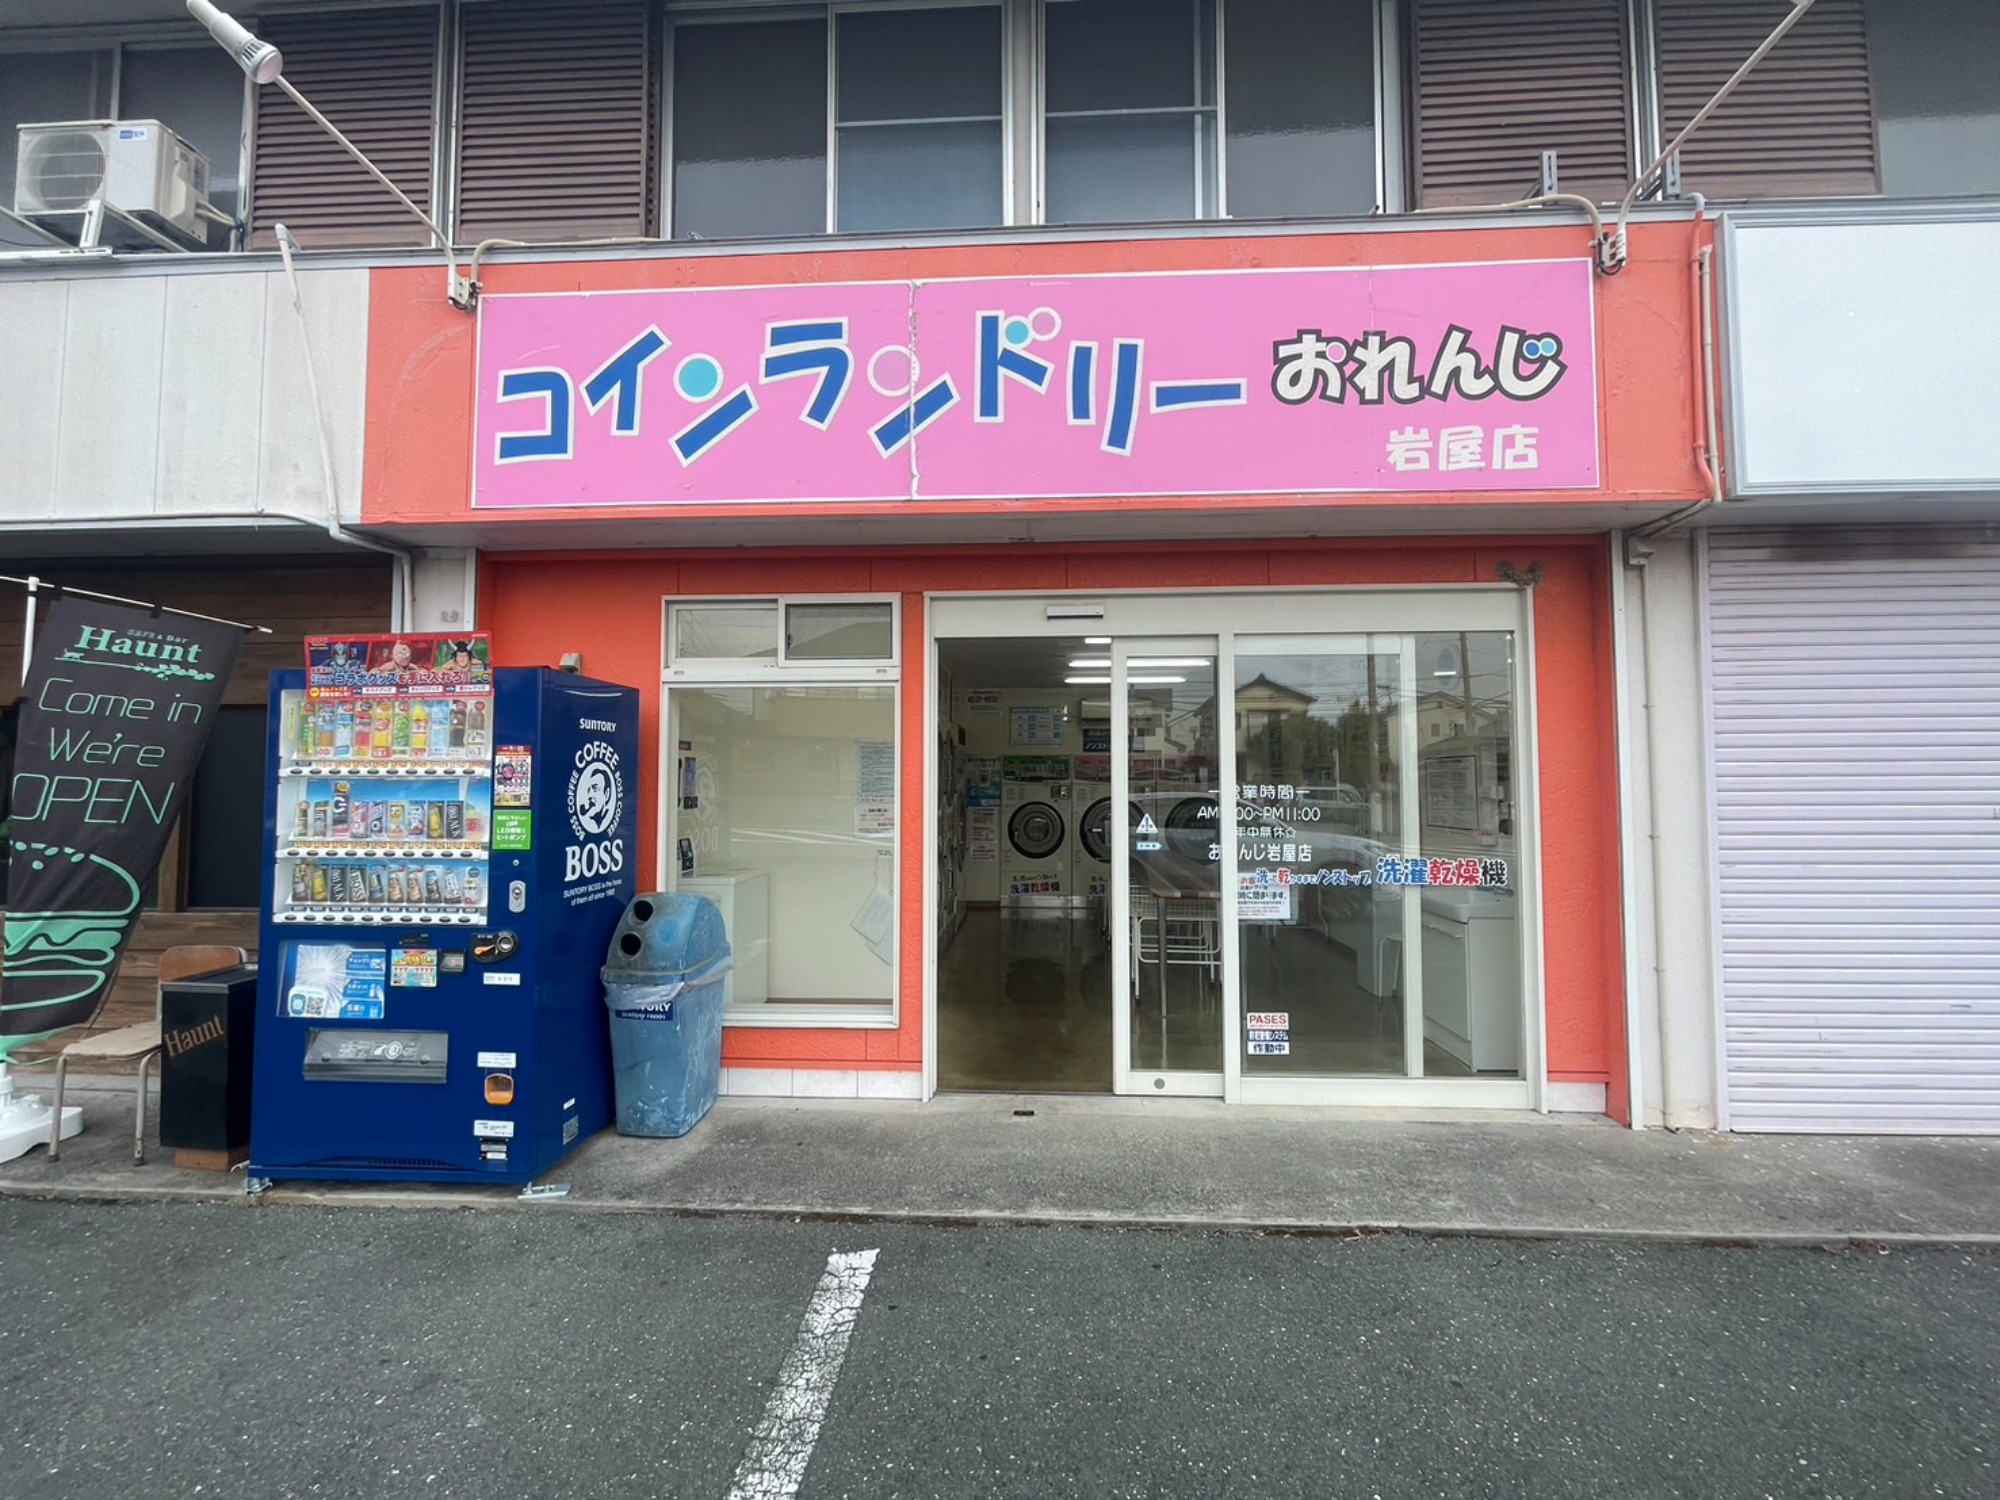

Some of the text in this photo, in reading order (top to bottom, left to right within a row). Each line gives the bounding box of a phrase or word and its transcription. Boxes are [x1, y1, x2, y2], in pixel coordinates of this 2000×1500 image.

[494, 306, 1568, 468] コインランドリー おれんじ
[1386, 423, 1539, 472] 岩屋店
[74, 625, 202, 663] Haunt
[38, 677, 203, 724] Come in
[579, 718, 617, 732] SUNTORY
[50, 727, 165, 768] We're
[575, 741, 620, 770] COFFEE
[11, 772, 175, 825] OPEN
[567, 771, 580, 814] COFFEE
[607, 802, 624, 838] COFFEE
[564, 839, 624, 882] BOSS
[1208, 843, 1313, 863] おんじ岩屋店
[1375, 857, 1508, 888] 洗濯乾燥機
[563, 887, 587, 898] SUNTORY
[164, 1014, 225, 1057] Haunt
[1249, 1014, 1287, 1025] PASES
[1253, 1043, 1286, 1054] 作動中
